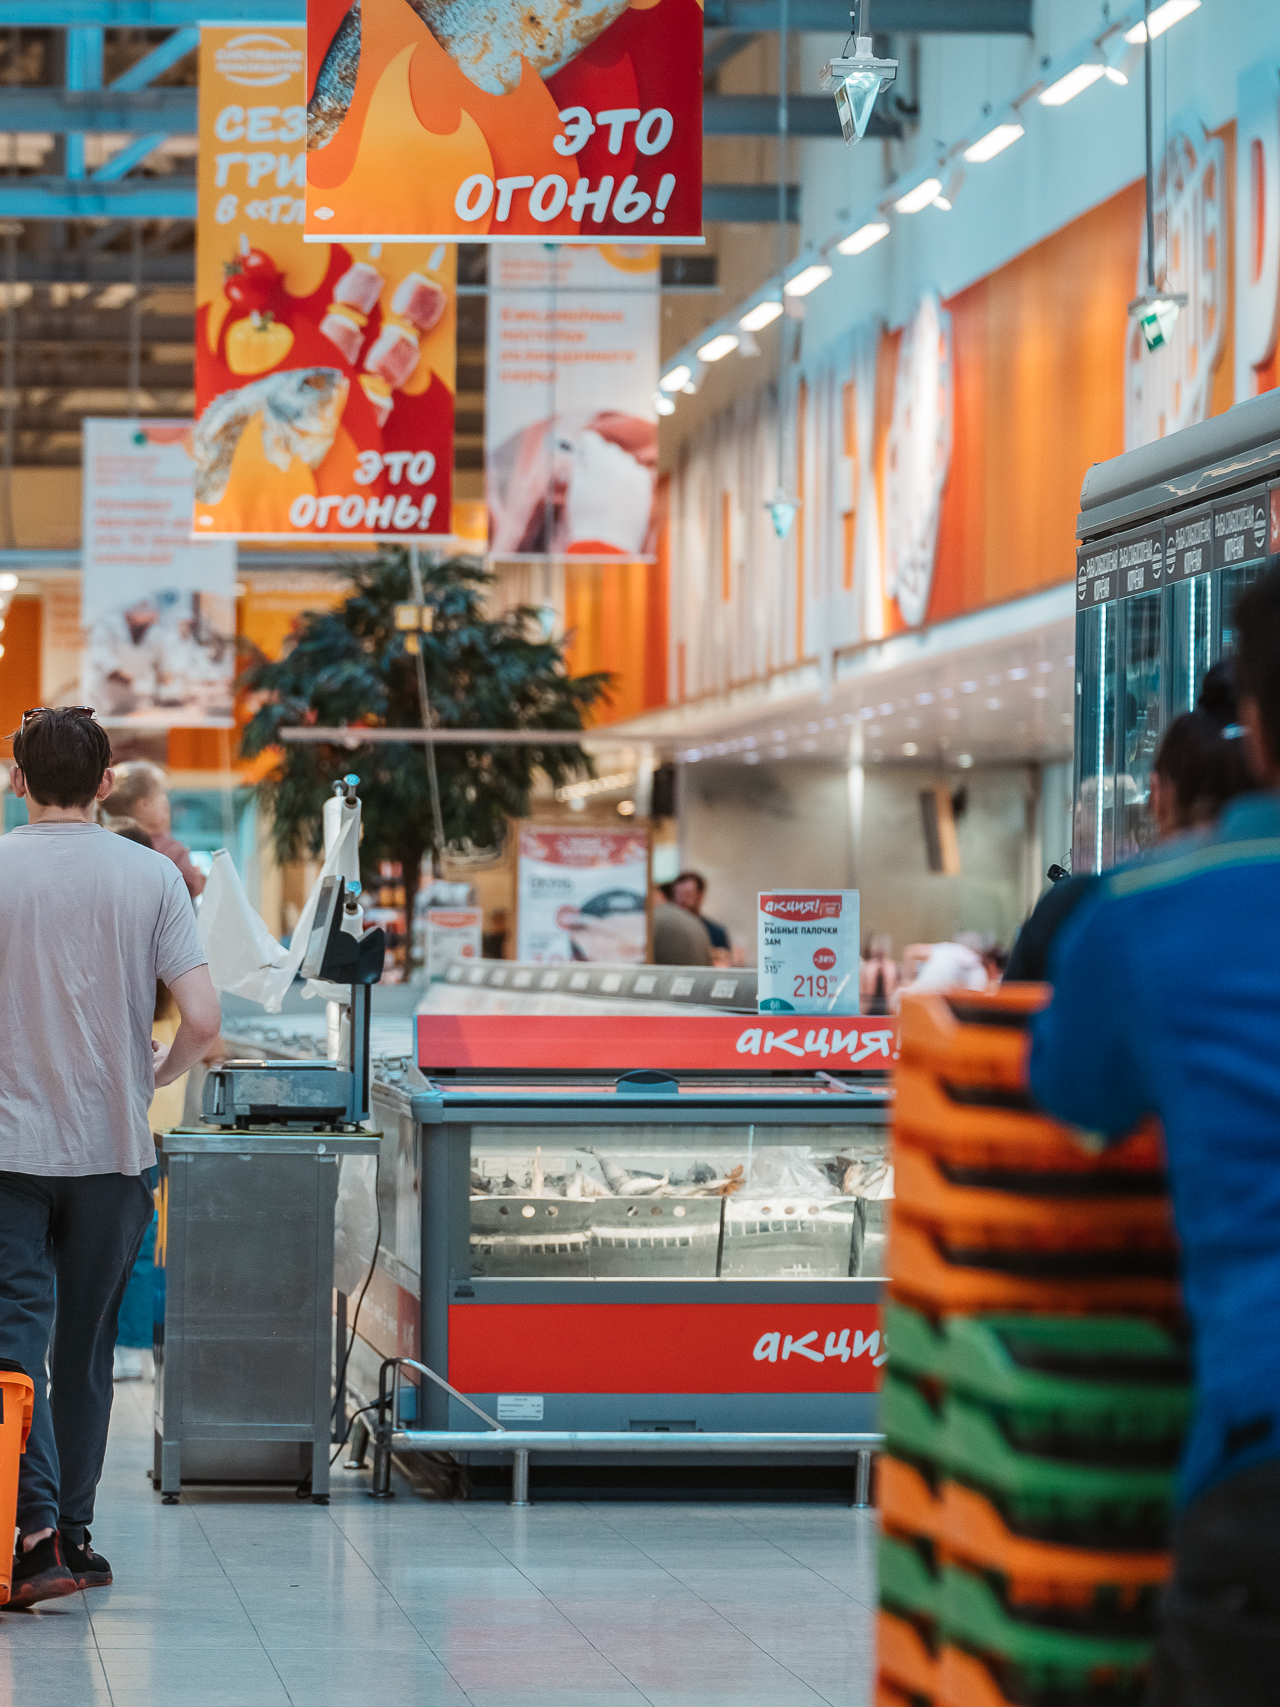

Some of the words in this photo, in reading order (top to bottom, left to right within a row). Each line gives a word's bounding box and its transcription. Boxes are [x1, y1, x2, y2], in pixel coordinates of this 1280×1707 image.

[552, 106, 674, 156] ЭТО
[454, 172, 677, 224] ОГОНЬ!
[354, 451, 436, 485] ЭТО
[289, 494, 437, 530] ОГОНЬ!
[764, 899, 820, 914] акция!
[764, 938, 781, 946] ЗАМ
[793, 975, 828, 998] 219
